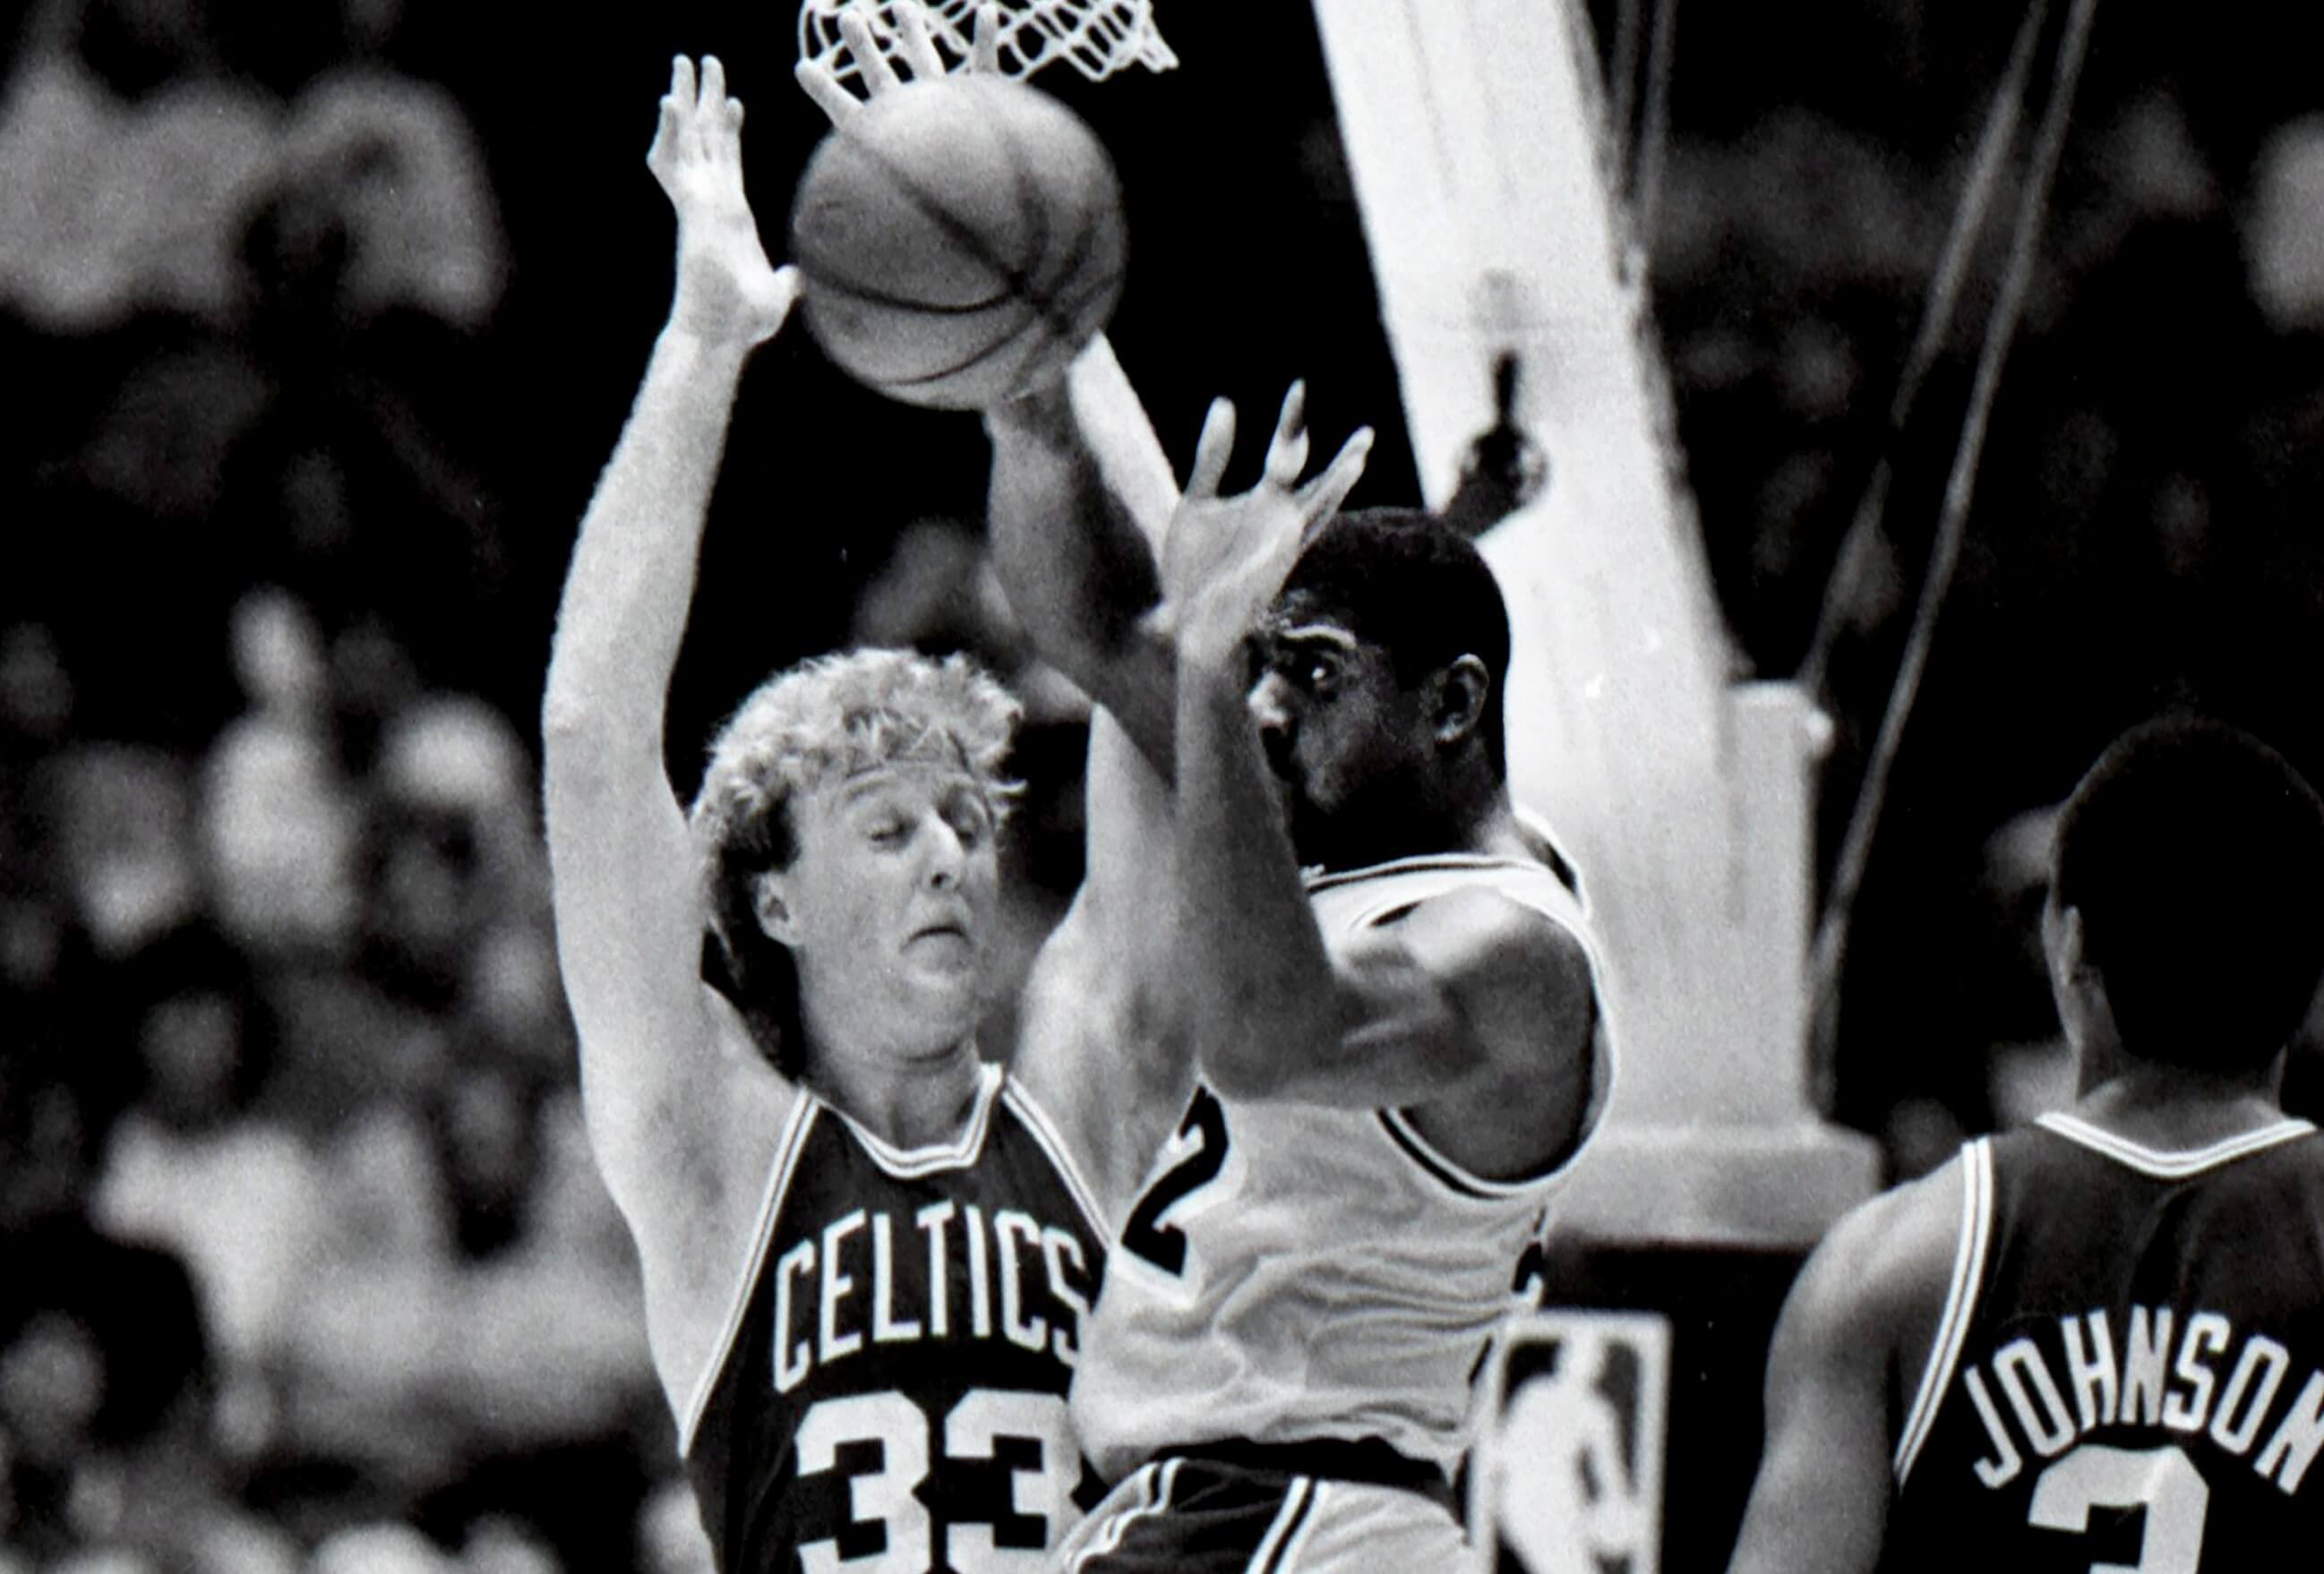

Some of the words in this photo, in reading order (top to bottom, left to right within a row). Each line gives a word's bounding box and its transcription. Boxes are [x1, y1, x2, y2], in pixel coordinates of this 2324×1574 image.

[773, 1200, 1090, 1394] CELTICS
[795, 1389, 1085, 1574] 33
[1965, 1305, 2324, 1494] JOHNSON
